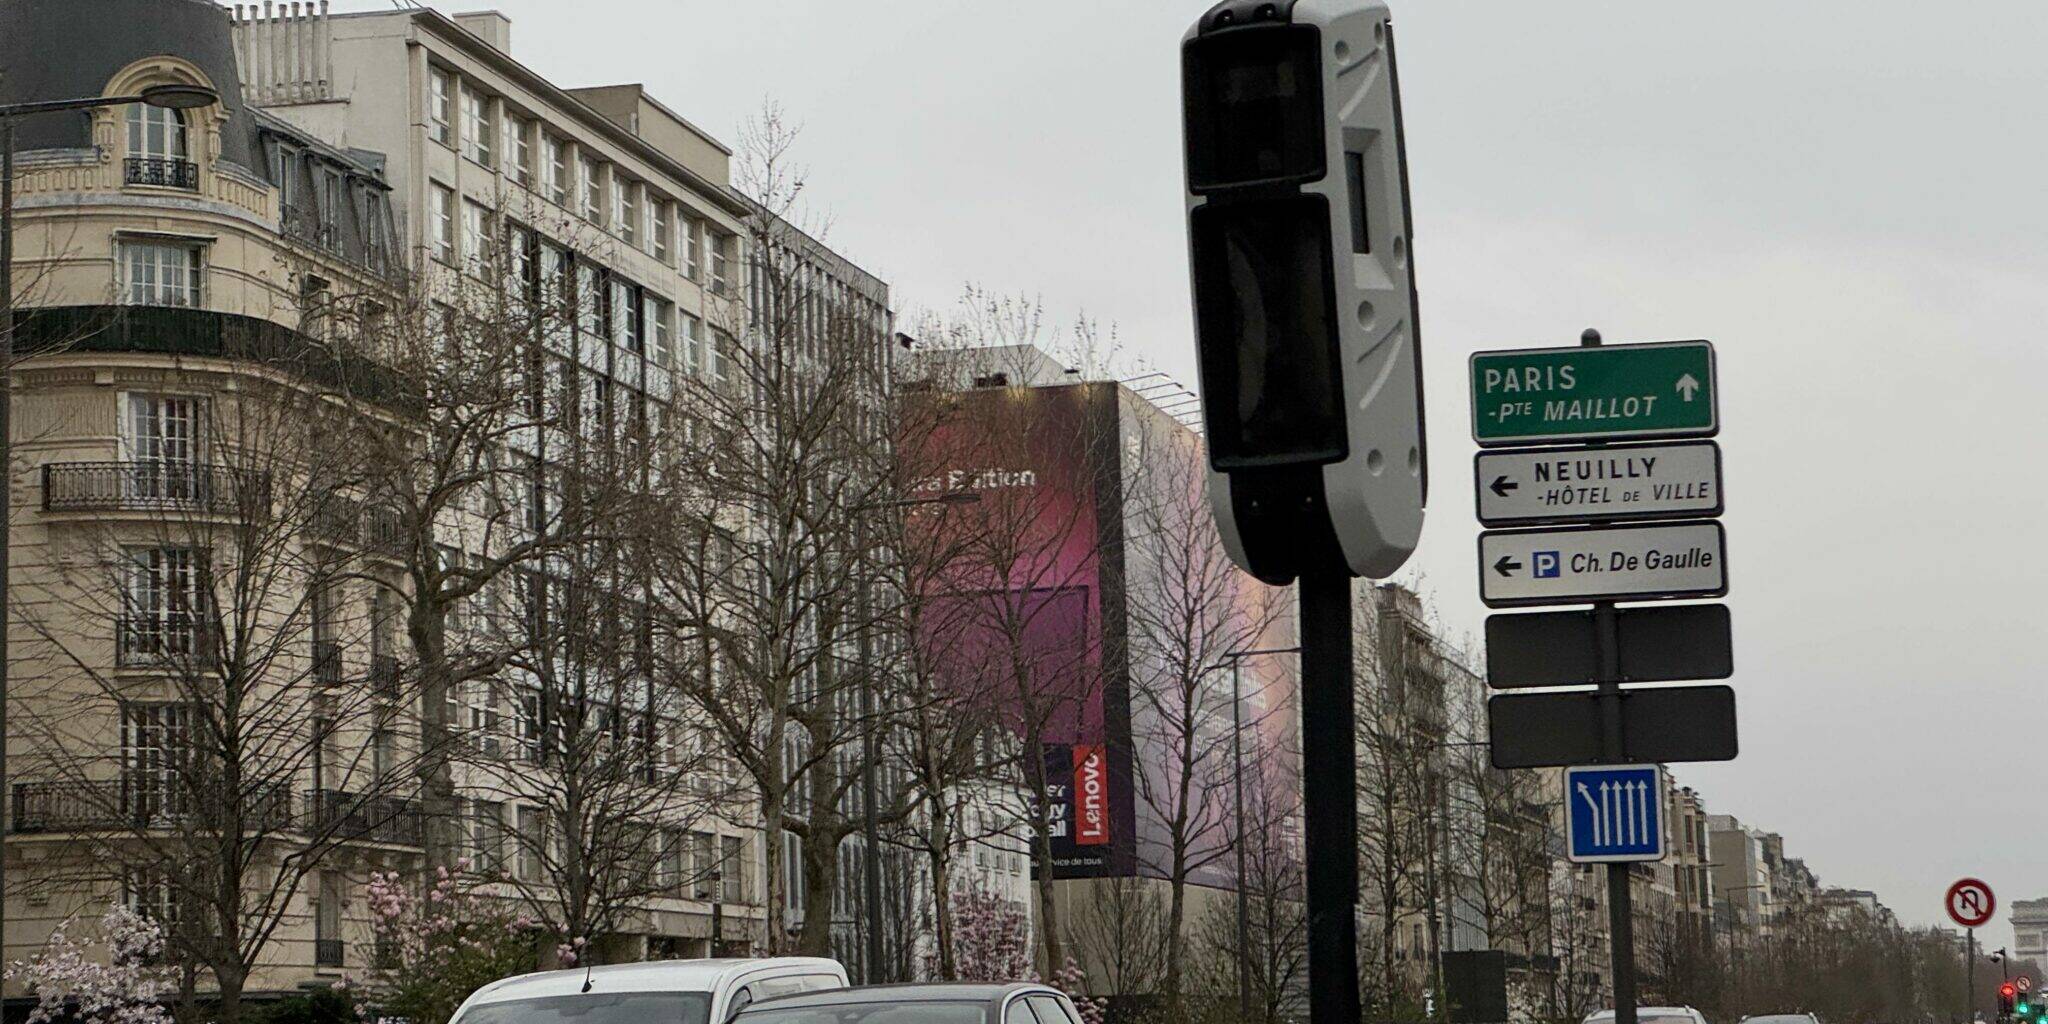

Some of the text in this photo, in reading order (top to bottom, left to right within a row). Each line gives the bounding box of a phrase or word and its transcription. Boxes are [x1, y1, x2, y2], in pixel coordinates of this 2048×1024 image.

[1485, 365, 1576, 393] PARIS
[1543, 396, 1658, 421] MAILLOT
[1534, 457, 1656, 482] NEUILLY
[1622, 491, 1641, 502] DE
[1652, 482, 1710, 500] VILLE
[1570, 552, 1604, 574] Ch.
[1609, 551, 1639, 572] De
[1645, 547, 1713, 570] Gaulle
[1082, 753, 1102, 837] Lenovo
